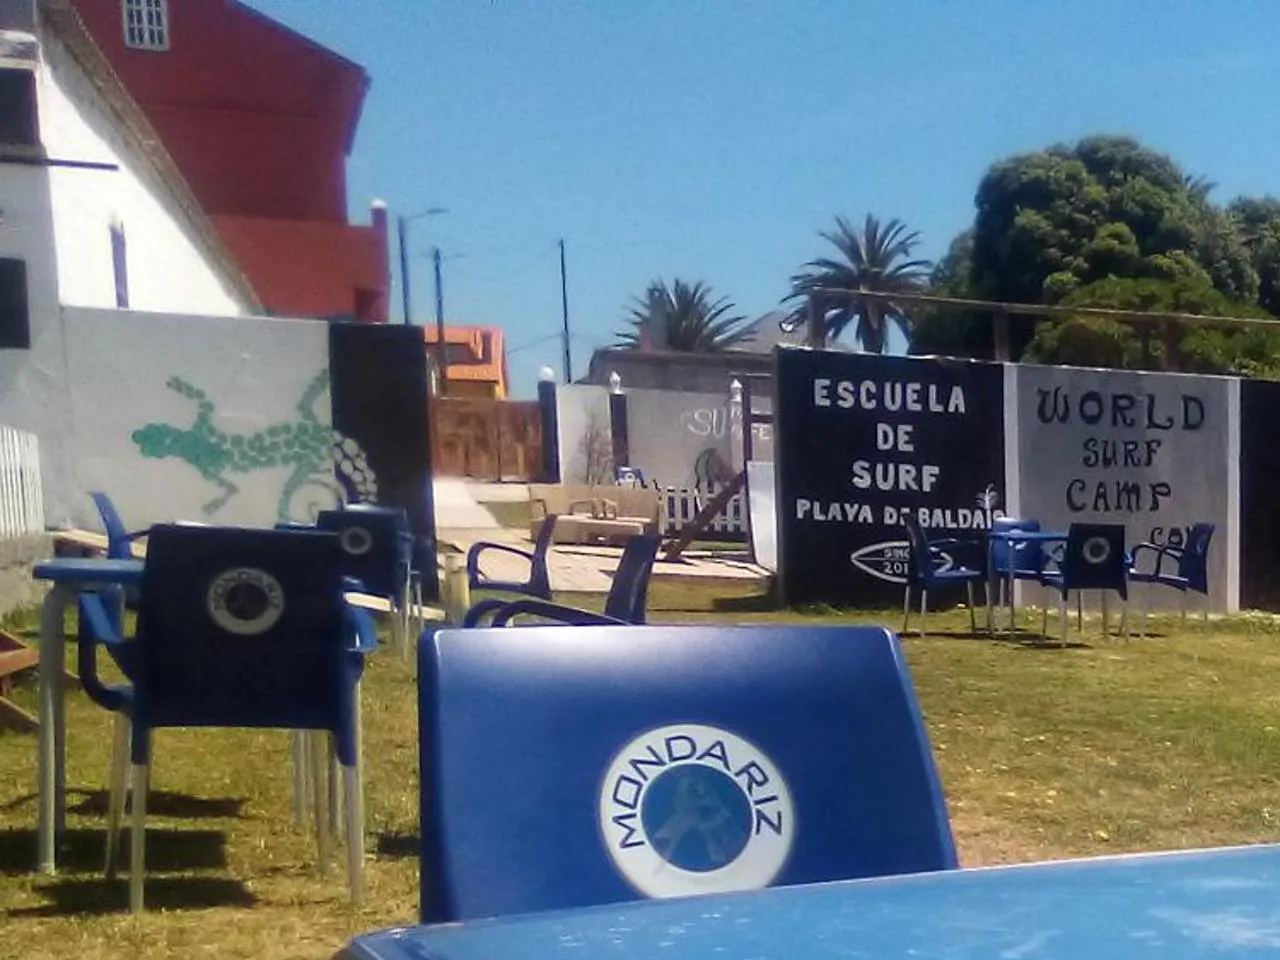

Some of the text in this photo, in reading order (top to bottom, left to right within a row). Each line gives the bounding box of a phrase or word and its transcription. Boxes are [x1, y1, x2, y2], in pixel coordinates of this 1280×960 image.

[814, 379, 965, 413] ESCUELA
[1037, 387, 1205, 430] WORLD
[877, 423, 914, 451] DE
[1082, 438, 1161, 468] SURF
[852, 460, 940, 492] SURF
[796, 499, 874, 525] PLAYA
[1066, 479, 1171, 513] CAMP
[884, 562, 909, 575] 201
[611, 735, 782, 849] MONDARIZ
